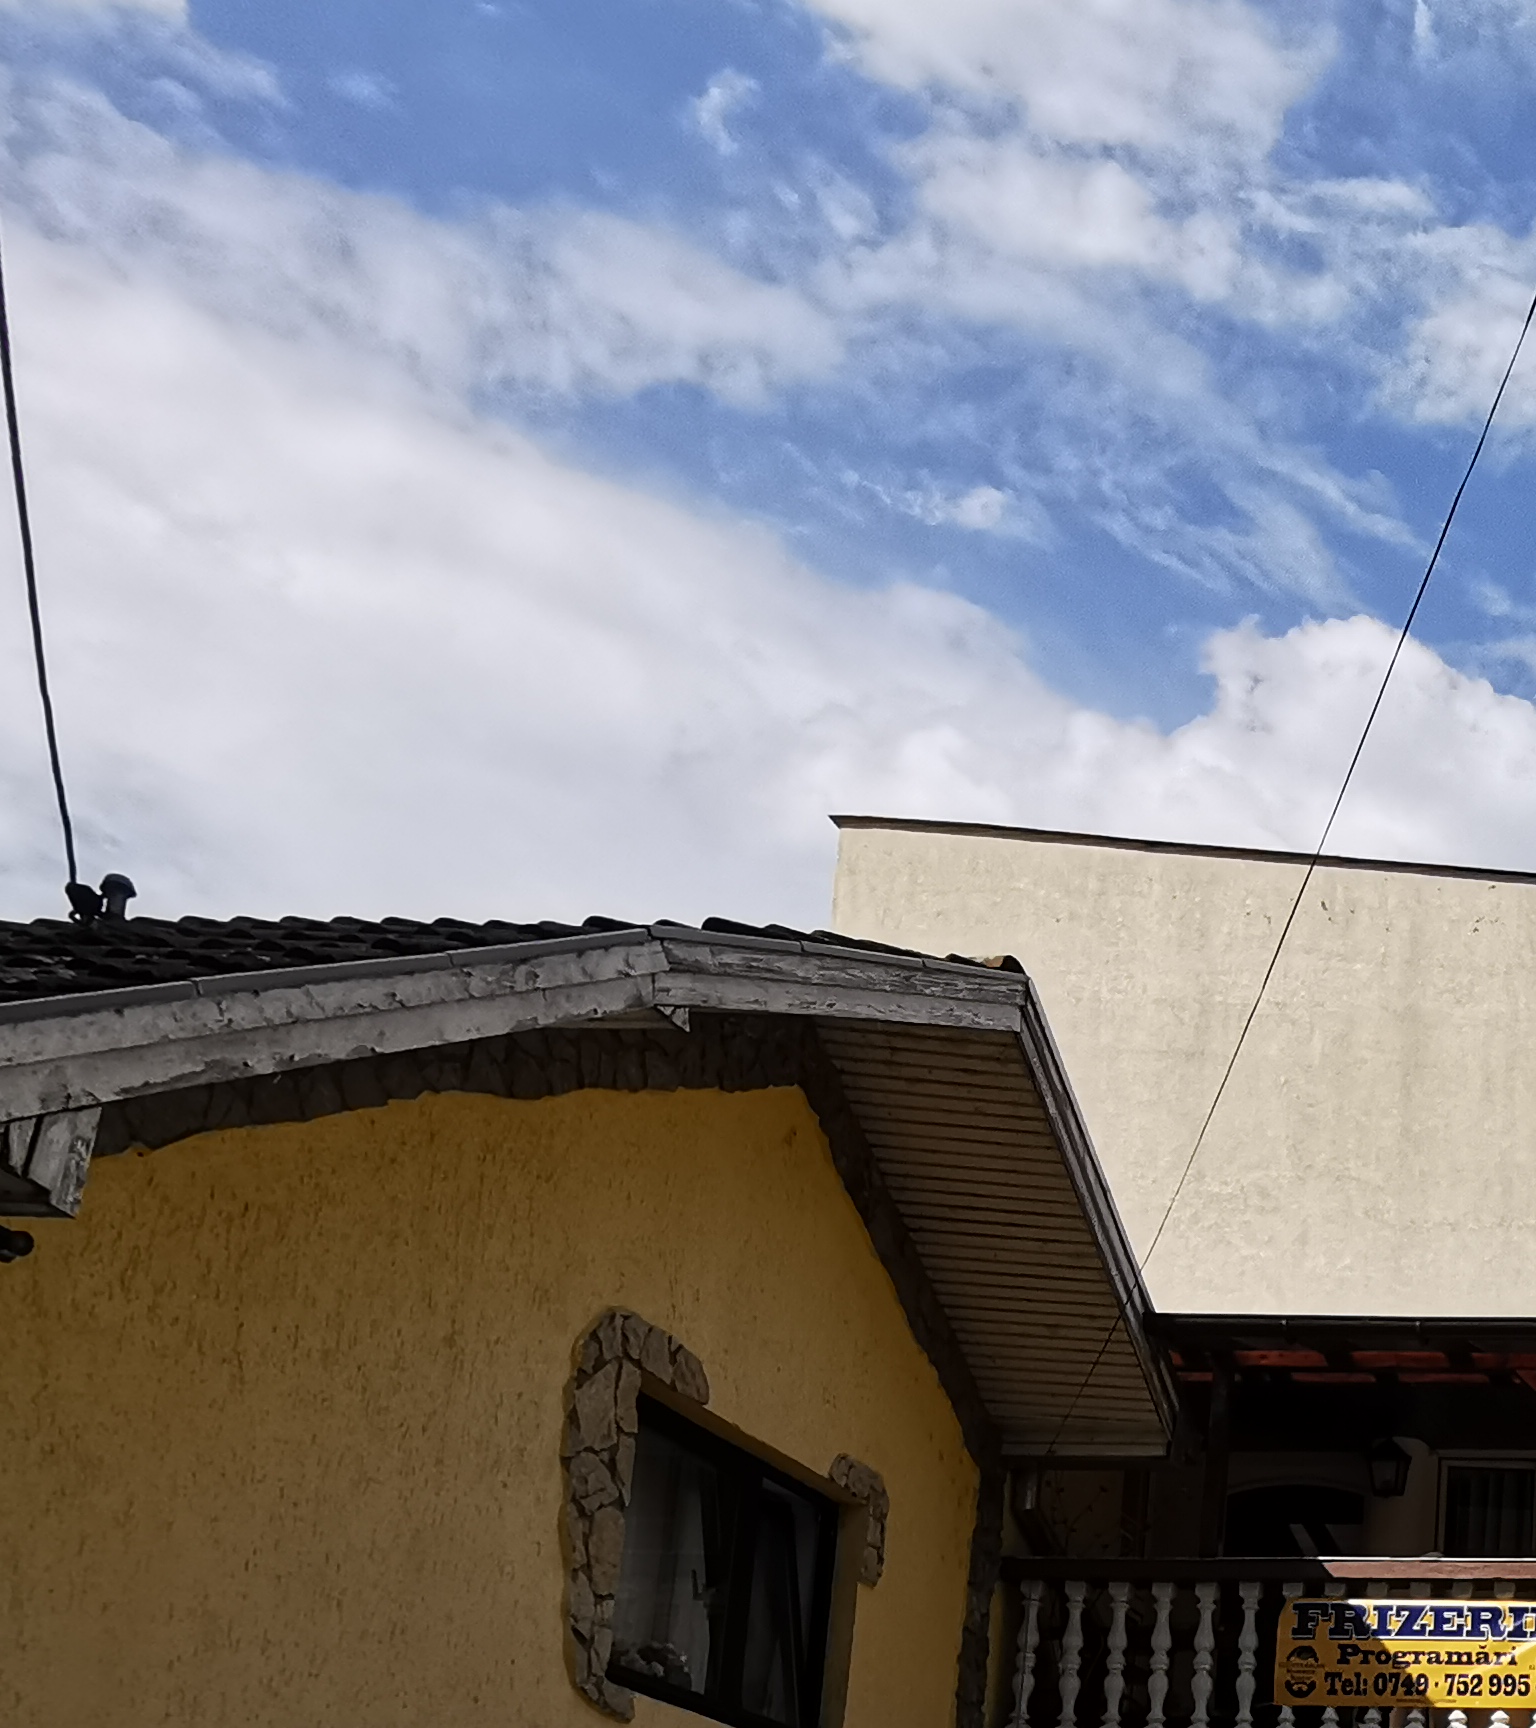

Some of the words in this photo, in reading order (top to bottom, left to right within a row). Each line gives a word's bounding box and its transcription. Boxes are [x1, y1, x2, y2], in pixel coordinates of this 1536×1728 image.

[1336, 1643, 1518, 1669] Programări
[1373, 1673, 1429, 1696] 0749
[1444, 1673, 1483, 1696] 752
[1488, 1673, 1531, 1697] 995
